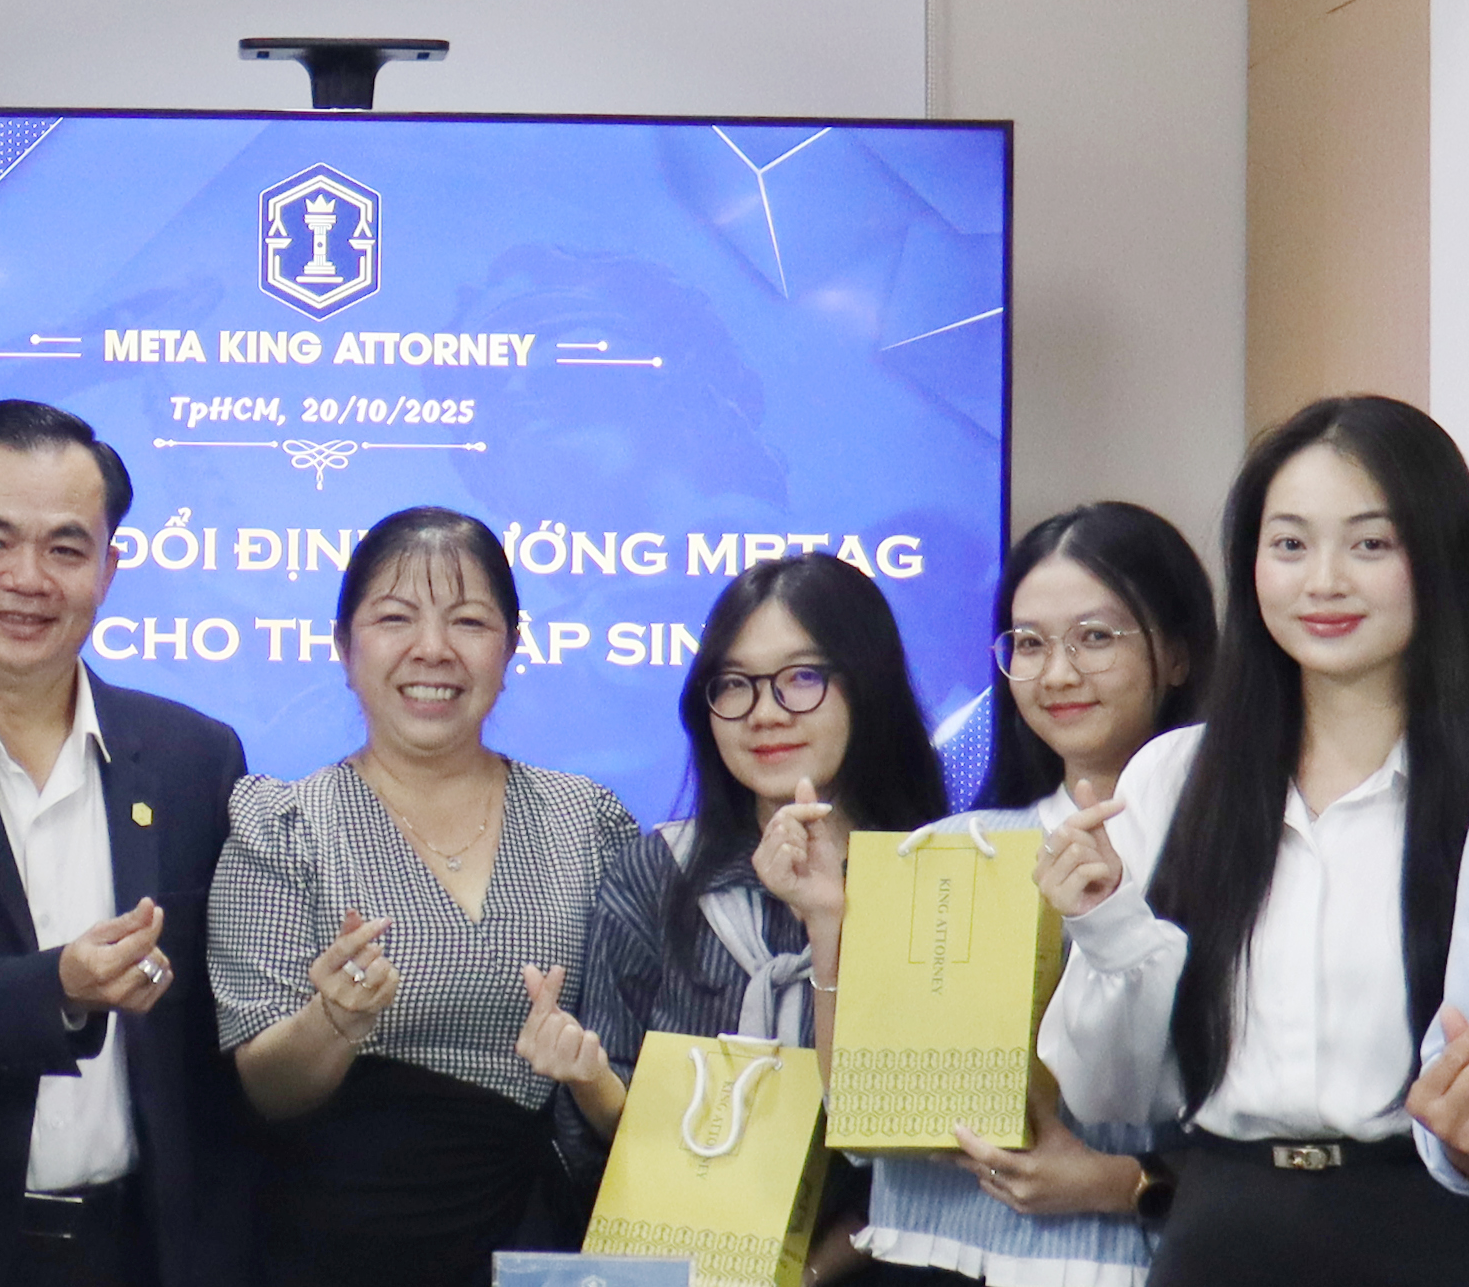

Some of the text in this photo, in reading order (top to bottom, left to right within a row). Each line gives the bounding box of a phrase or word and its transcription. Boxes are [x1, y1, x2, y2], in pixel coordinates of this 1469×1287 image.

[103, 329, 537, 367] META KING ATTORNEY
[300, 394, 476, 426] 20/10/2025
[233, 528, 369, 582] ĐỊN
[91, 616, 241, 662] CHO
[931, 878, 951, 996] KING ATTORNEY
